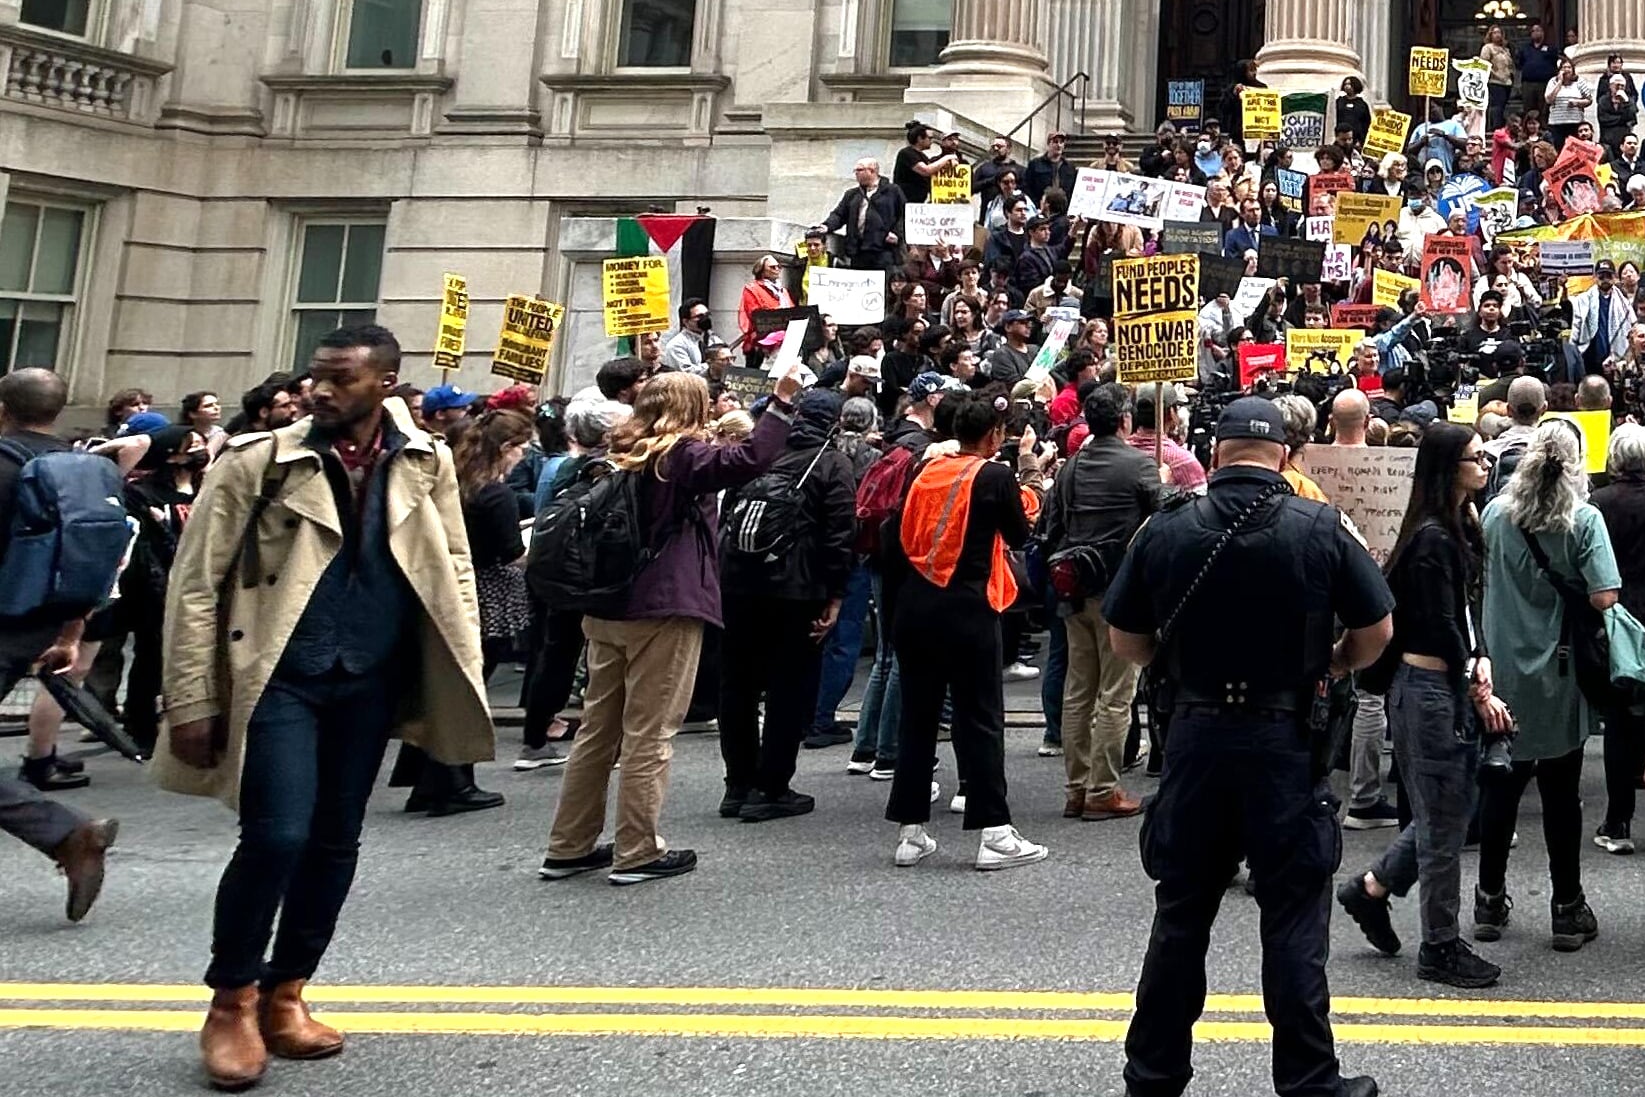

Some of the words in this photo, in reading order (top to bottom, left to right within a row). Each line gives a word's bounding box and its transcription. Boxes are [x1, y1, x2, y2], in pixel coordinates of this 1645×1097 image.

[1412, 56, 1446, 72] NEEDS
[1282, 127, 1321, 138] OWER
[606, 260, 640, 272] MONEY
[1116, 265, 1144, 279] FUND
[1148, 260, 1195, 276] PEOPLE'S
[1116, 274, 1195, 312] NEEDS
[511, 297, 527, 308] THE
[606, 299, 623, 308] NOT
[508, 307, 553, 333] UNITED
[1118, 323, 1152, 345] NOT
[1155, 320, 1194, 341] WAR
[1120, 342, 1184, 361] GENOCIDE
[1187, 340, 1194, 356] &
[1120, 358, 1194, 371] DEPORTATION
